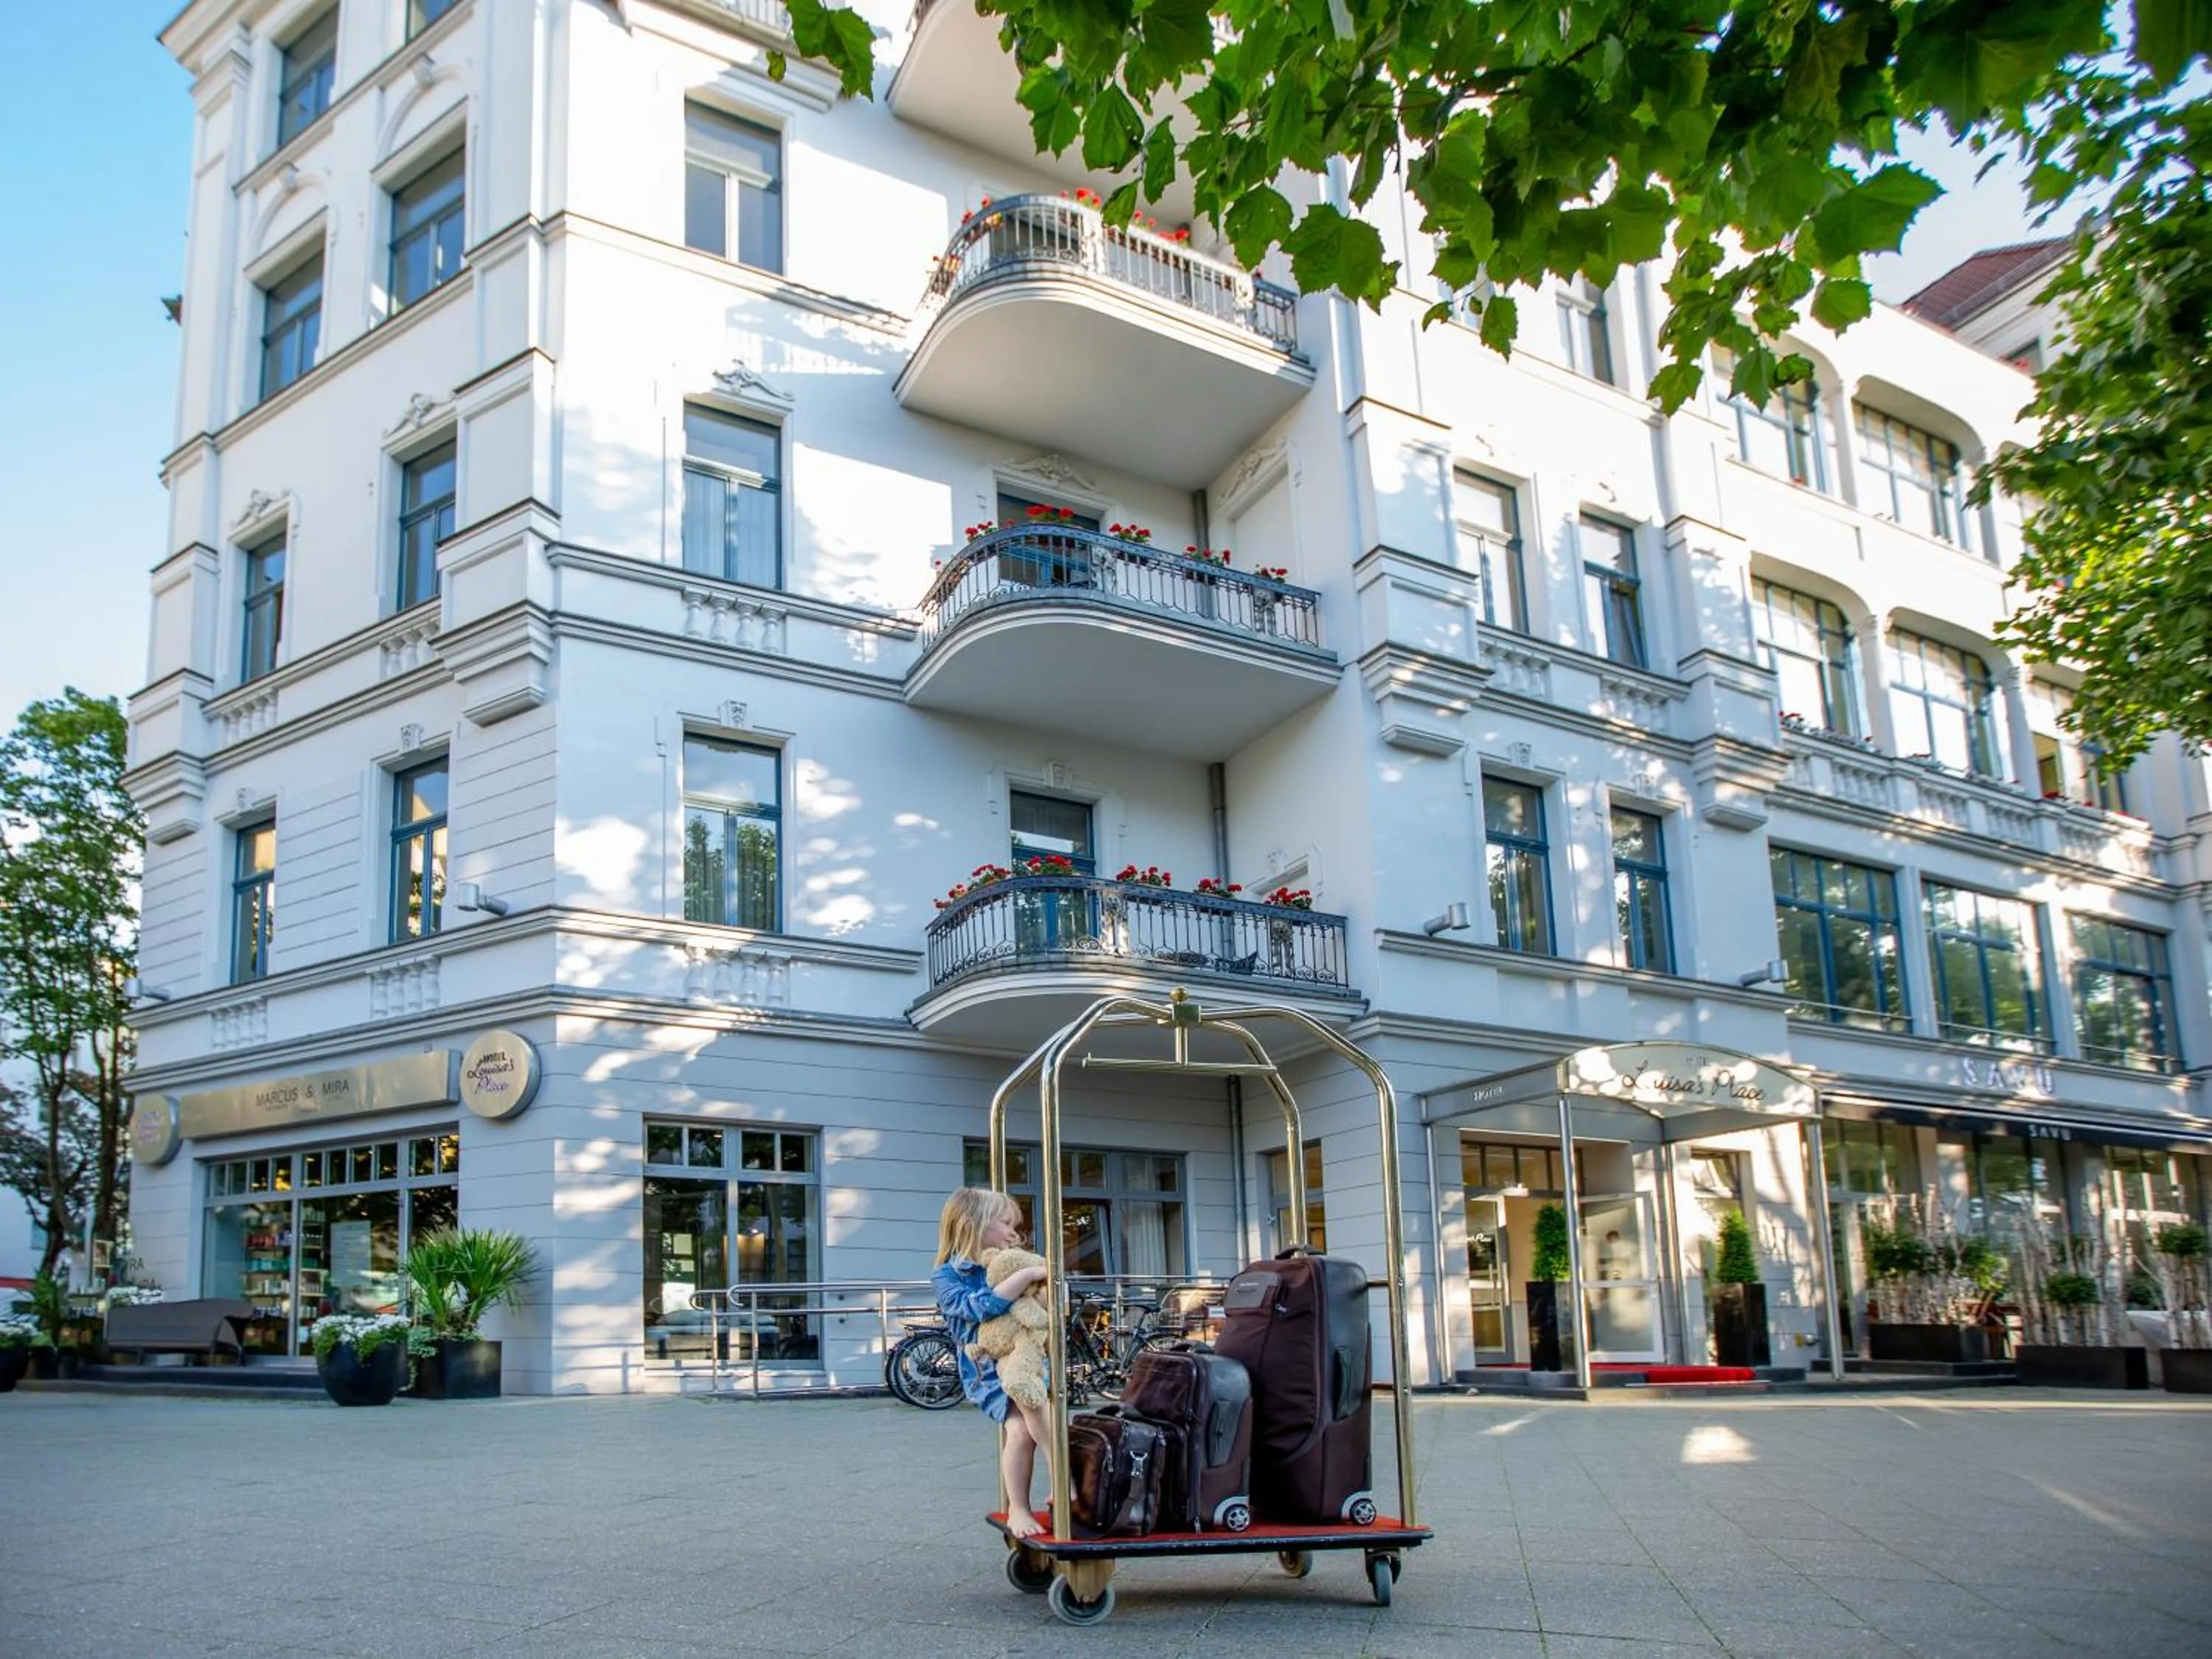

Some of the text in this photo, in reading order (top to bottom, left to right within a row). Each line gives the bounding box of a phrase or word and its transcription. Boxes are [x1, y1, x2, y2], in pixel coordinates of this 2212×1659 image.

[1711, 1069, 1767, 1101] Place
[1961, 1057, 2056, 1096] SAVU
[255, 1078, 349, 1107] MARCUS & MIRA
[2028, 1124, 2071, 1141] SAVU
